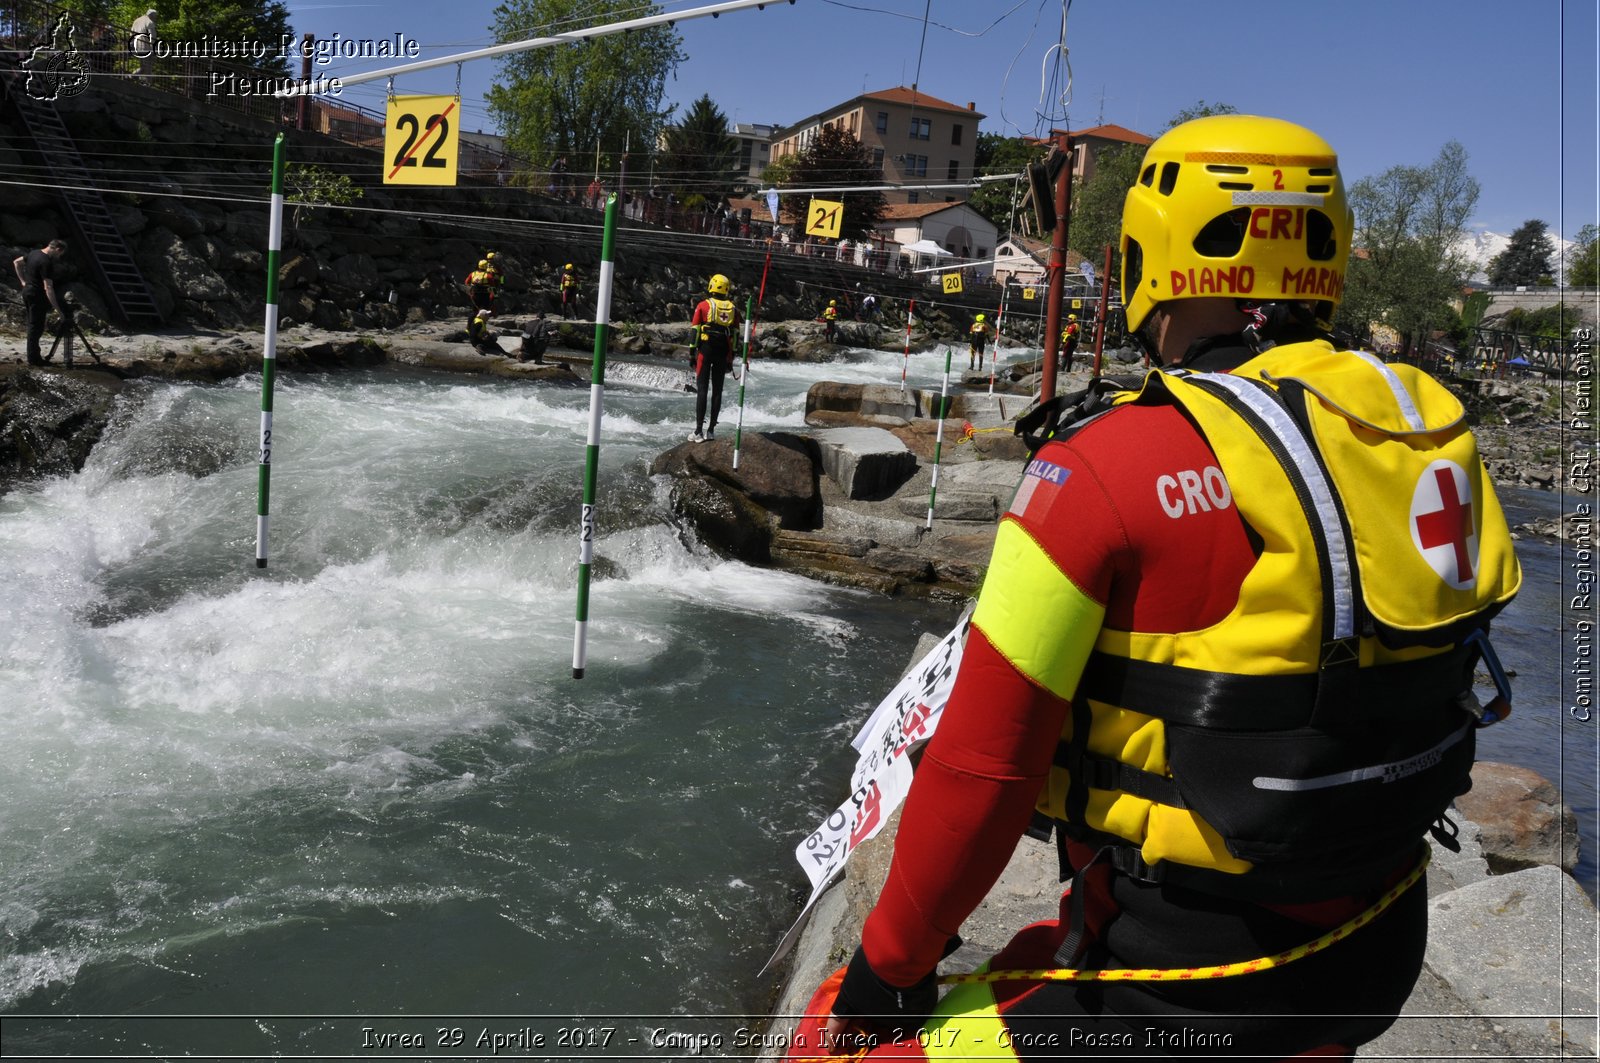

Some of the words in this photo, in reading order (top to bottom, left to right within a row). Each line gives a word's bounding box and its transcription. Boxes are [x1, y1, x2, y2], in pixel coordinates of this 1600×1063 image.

[393, 113, 449, 168] 22
[1272, 169, 1285, 190] 2
[814, 207, 836, 231] 21
[1250, 207, 1304, 240] CRI
[945, 277, 959, 290] 20
[1170, 265, 1255, 296] DIANO
[1156, 465, 1232, 519] CRO
